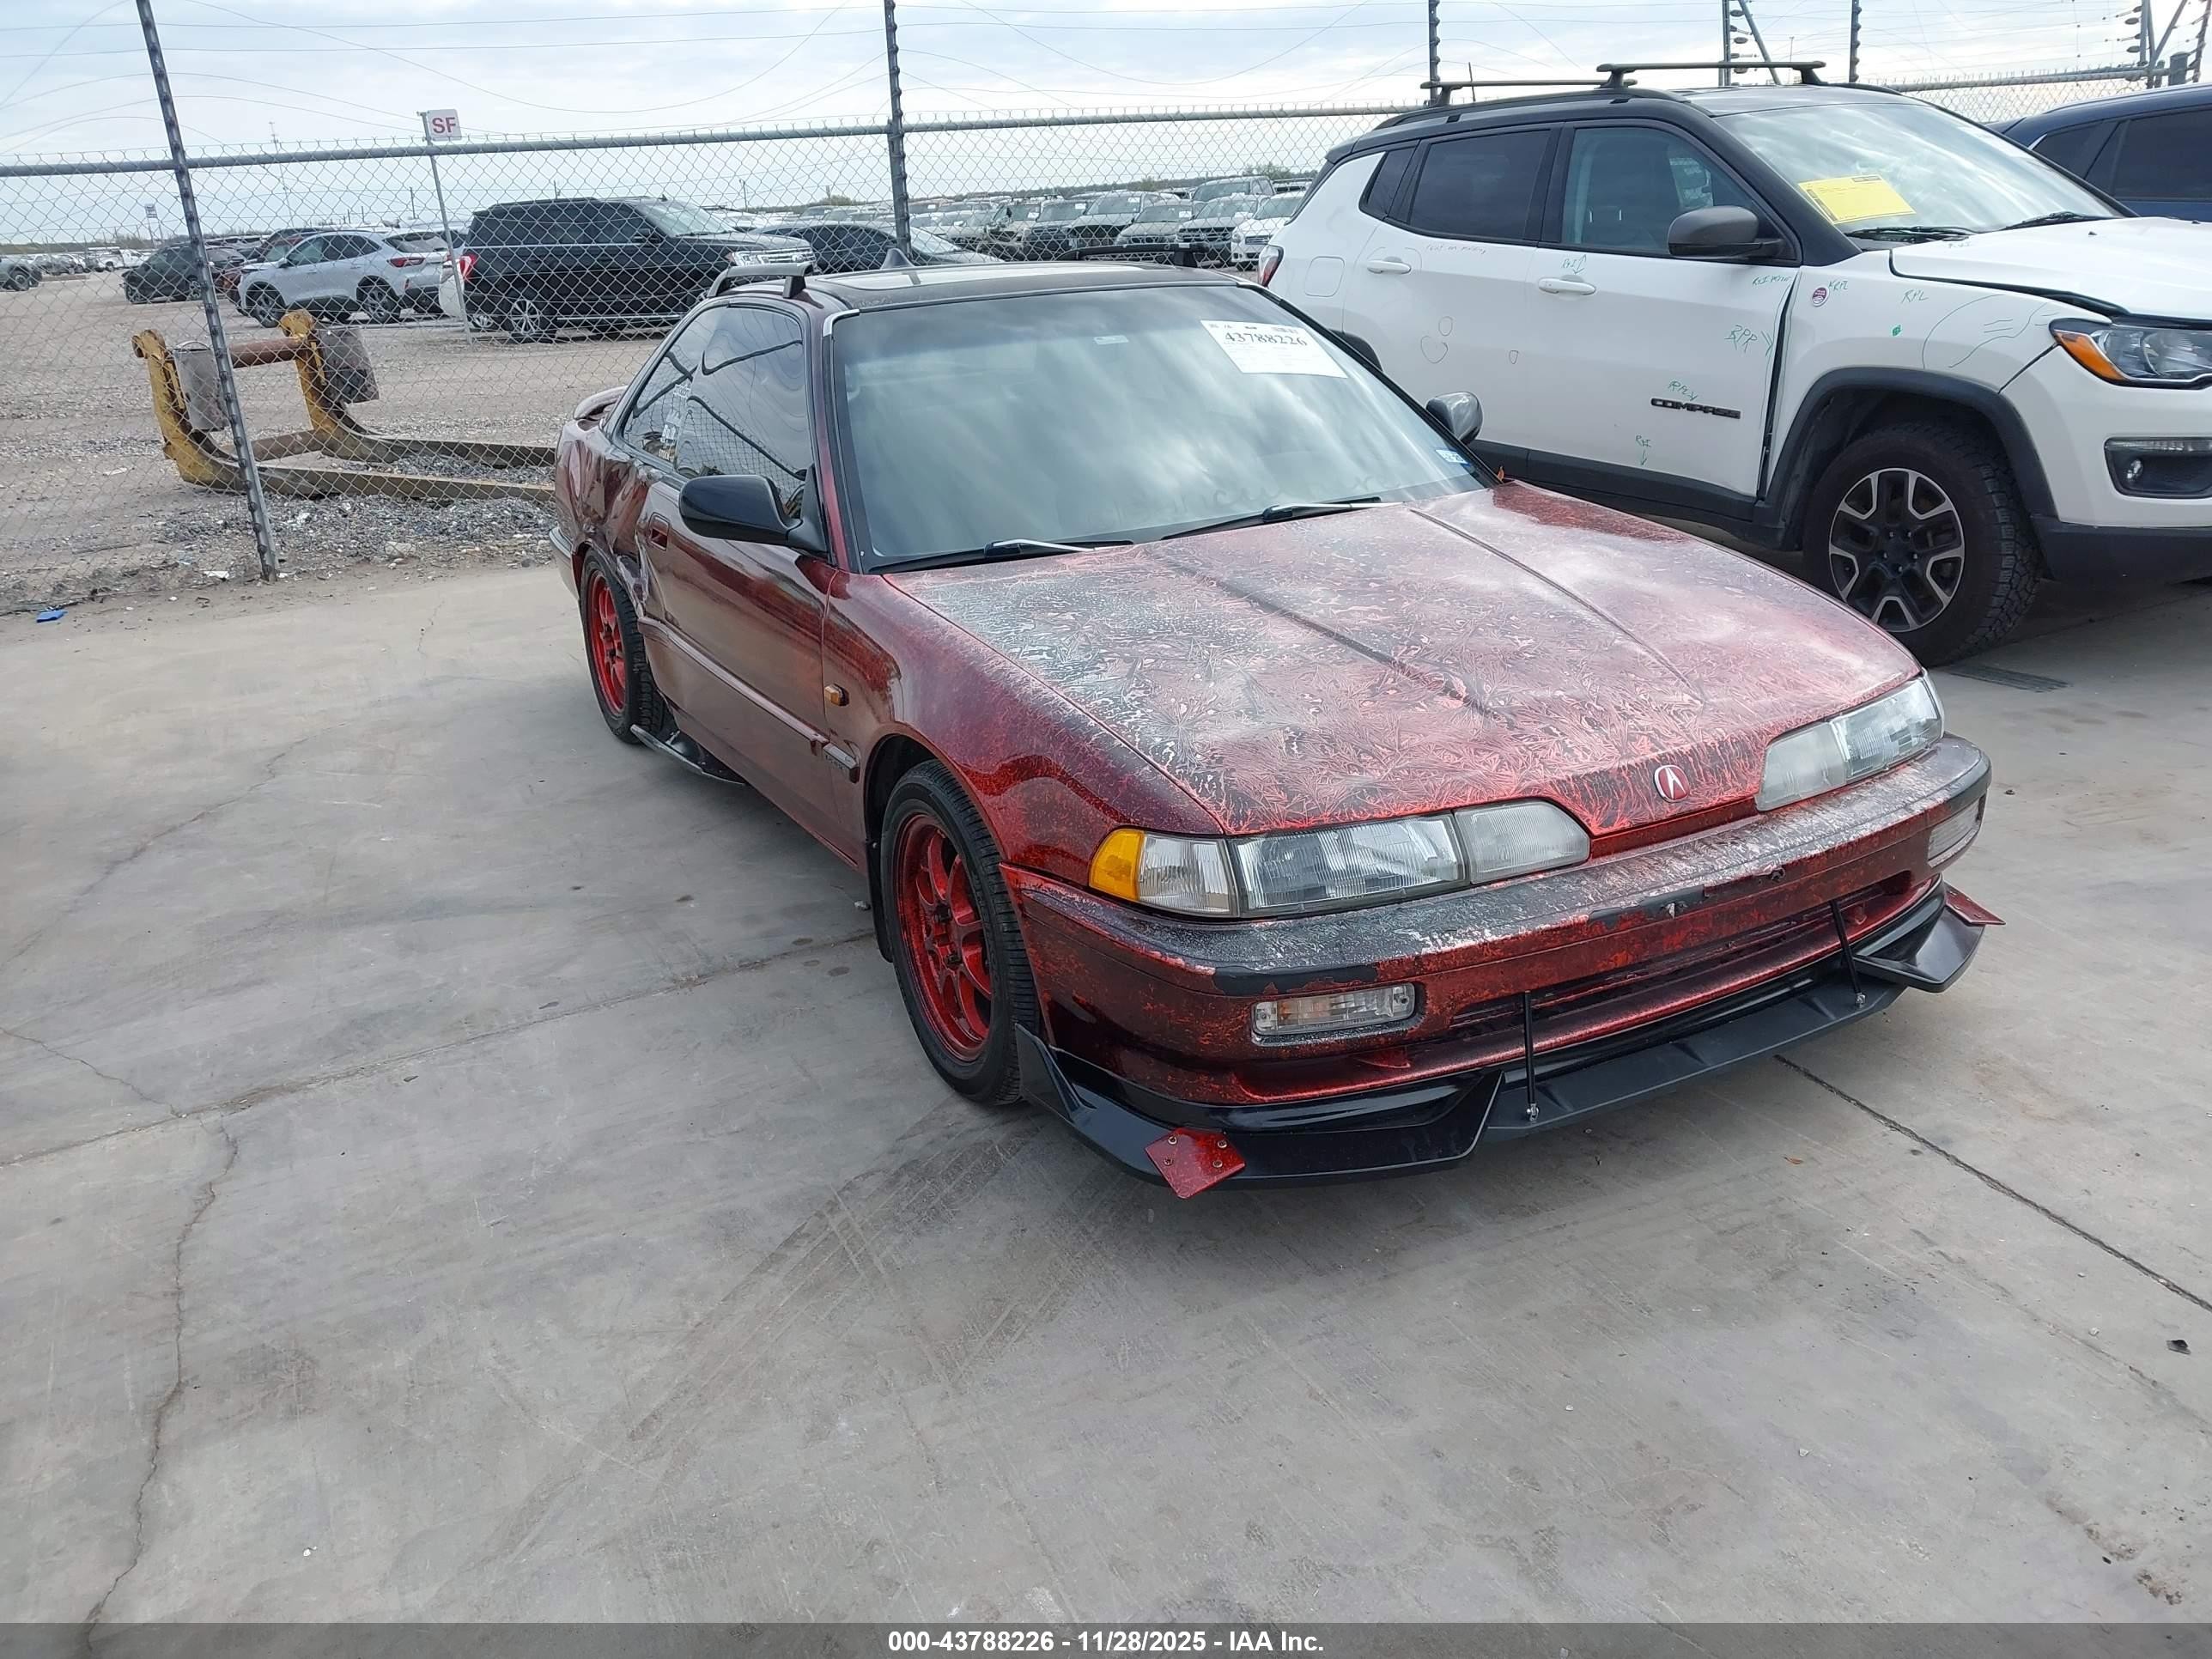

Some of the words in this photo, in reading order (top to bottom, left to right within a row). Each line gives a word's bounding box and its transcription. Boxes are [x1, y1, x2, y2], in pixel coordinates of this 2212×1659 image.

[432, 117, 456, 134] SF
[1225, 331, 1307, 346] 43788226
[1650, 398, 1741, 420] COMPASS
